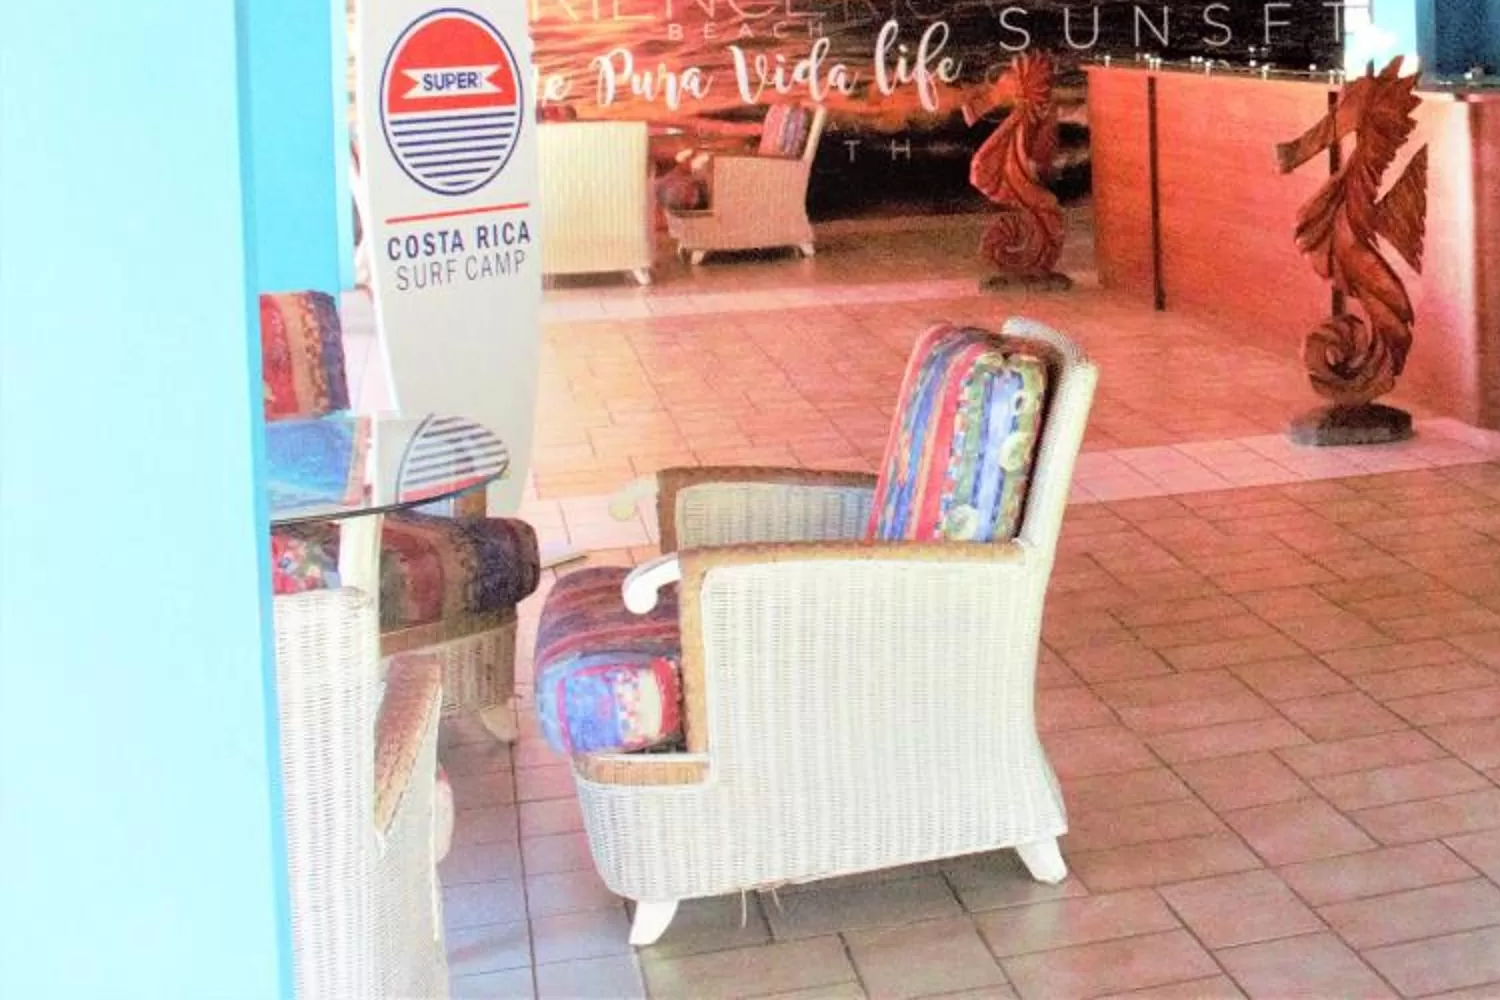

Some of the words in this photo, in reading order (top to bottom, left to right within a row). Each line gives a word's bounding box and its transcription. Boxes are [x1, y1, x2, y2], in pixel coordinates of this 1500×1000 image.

[422, 72, 478, 91] SUPER
[589, 48, 712, 111] Pura
[729, 36, 858, 106] Vida
[874, 19, 963, 112] life
[387, 228, 465, 261] COSTA
[477, 219, 531, 251] RICA
[396, 260, 457, 291] SURF
[465, 249, 526, 281] CAMP
